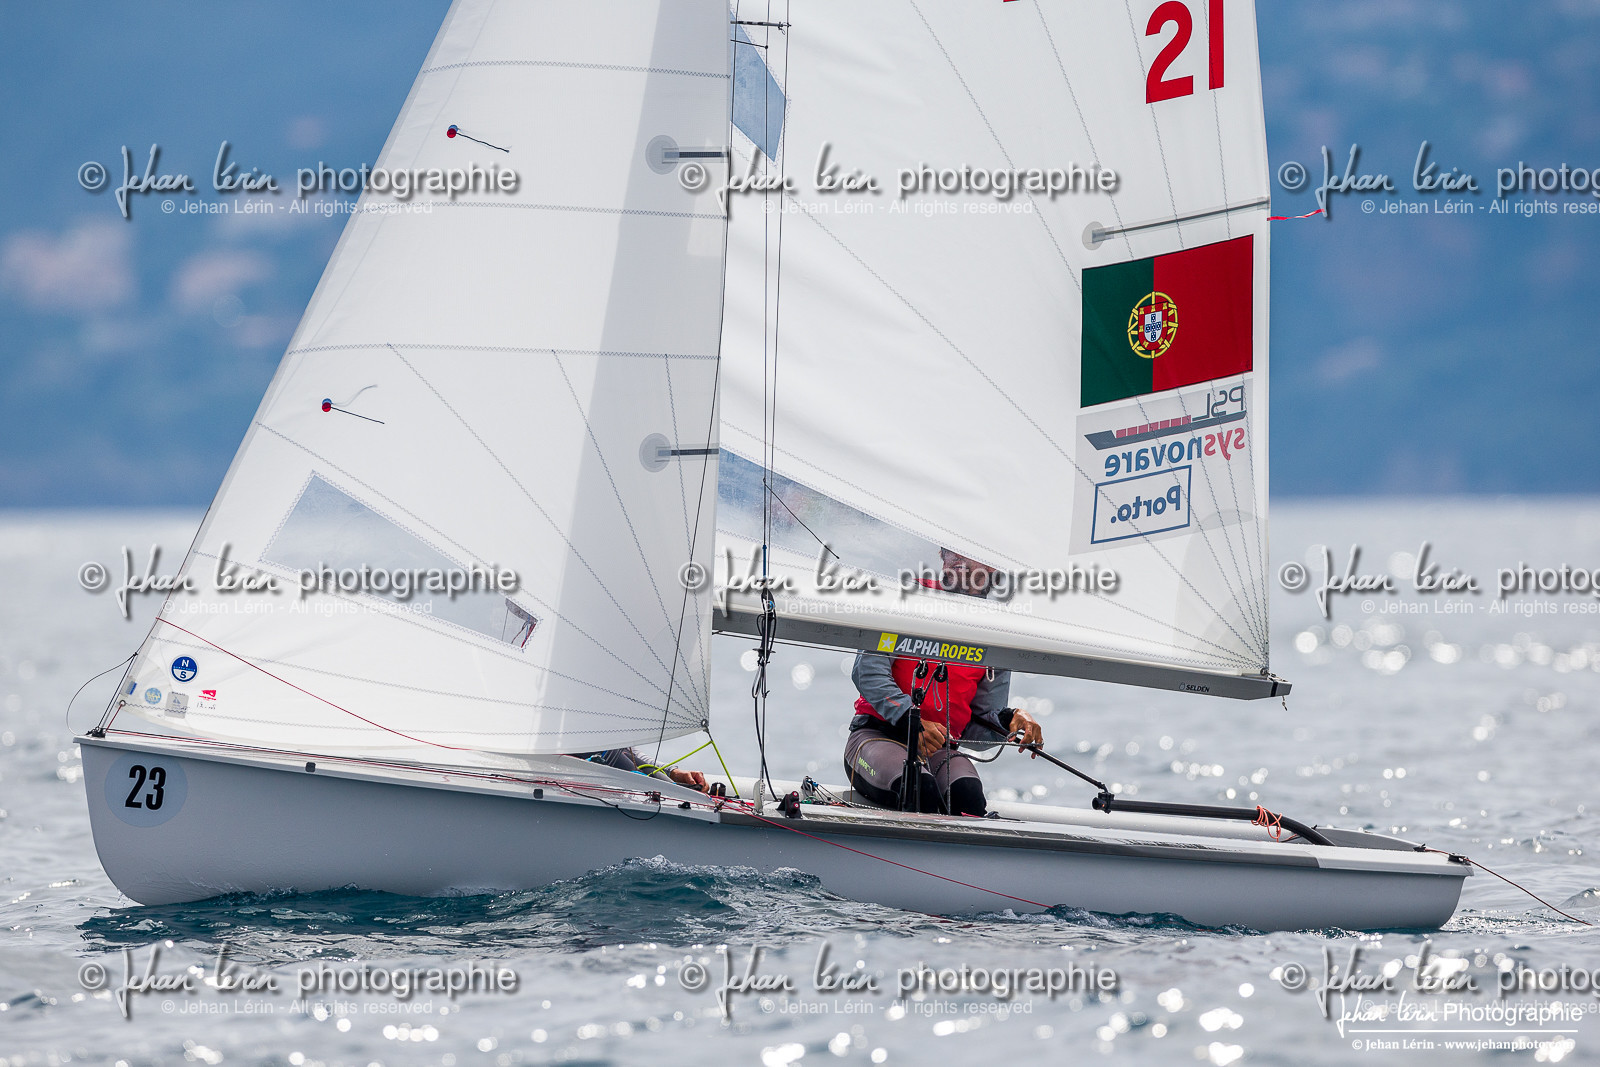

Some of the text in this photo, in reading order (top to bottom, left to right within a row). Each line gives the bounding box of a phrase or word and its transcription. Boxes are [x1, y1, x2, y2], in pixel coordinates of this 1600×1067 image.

[1146, 0, 1224, 104] 21
[895, 637, 984, 662] ALPHAROPES
[125, 764, 167, 811] 23
